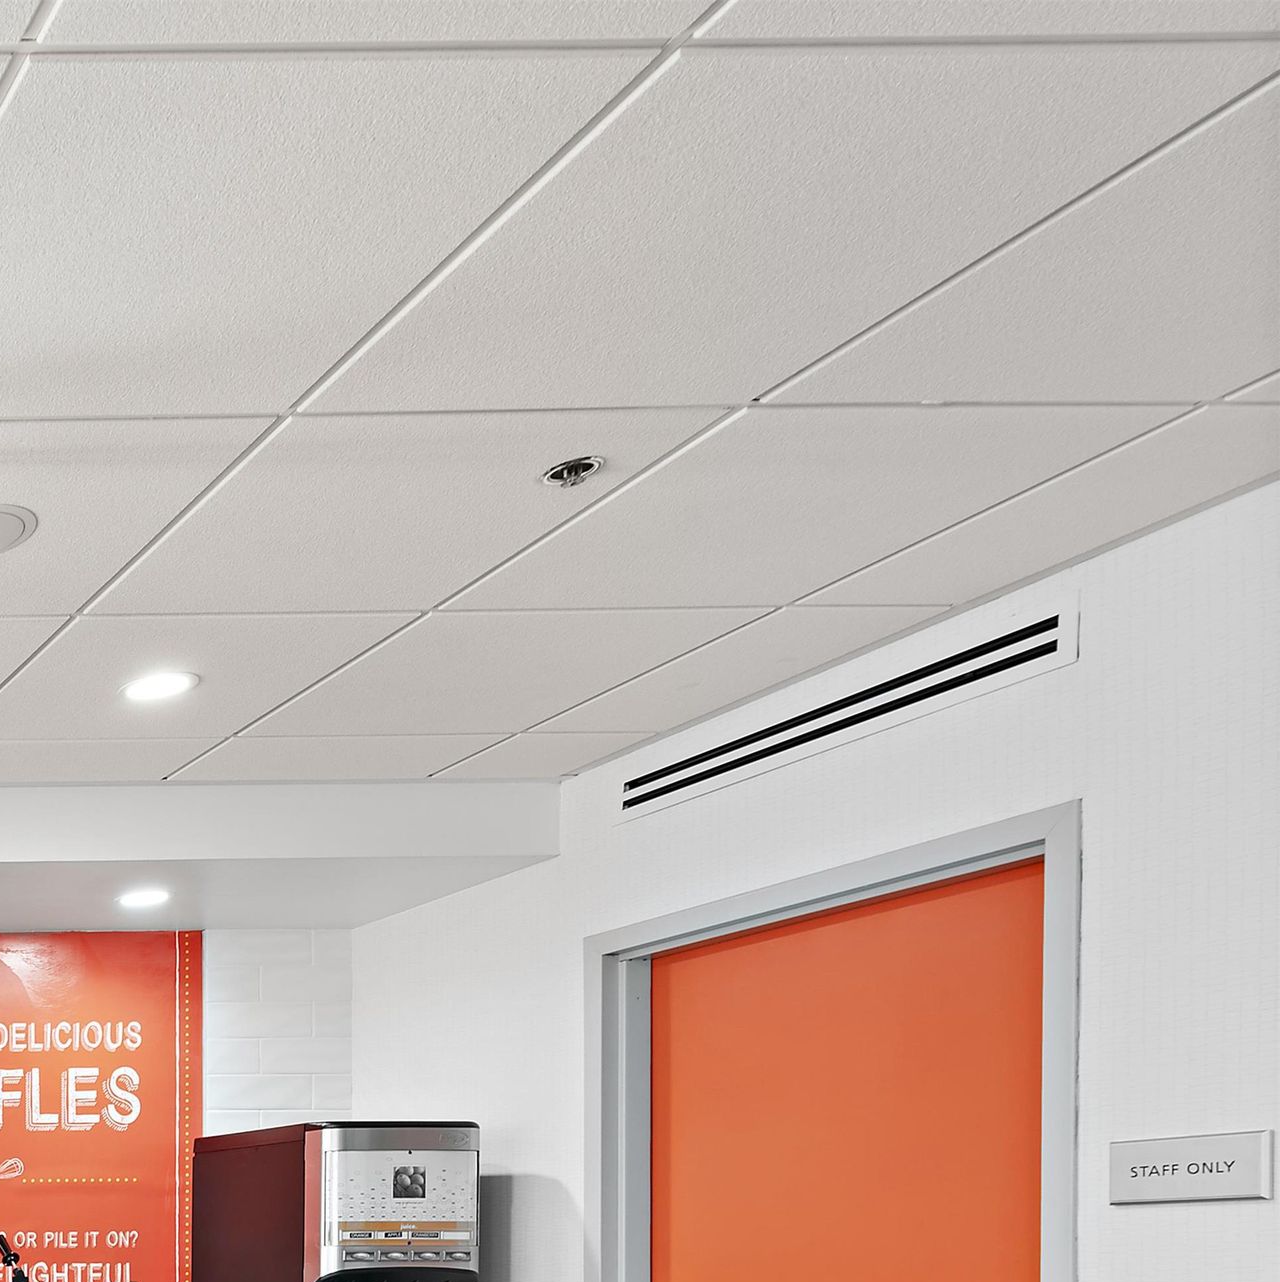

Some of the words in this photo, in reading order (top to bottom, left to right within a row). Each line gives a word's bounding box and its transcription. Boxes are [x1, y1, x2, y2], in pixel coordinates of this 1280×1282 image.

[1130, 1163, 1179, 1179] STAFF
[1186, 1159, 1236, 1175] ONLY
[13, 1231, 38, 1249] OR
[43, 1231, 79, 1249] PILE
[84, 1231, 100, 1248] IT
[105, 1230, 139, 1248] ON?
